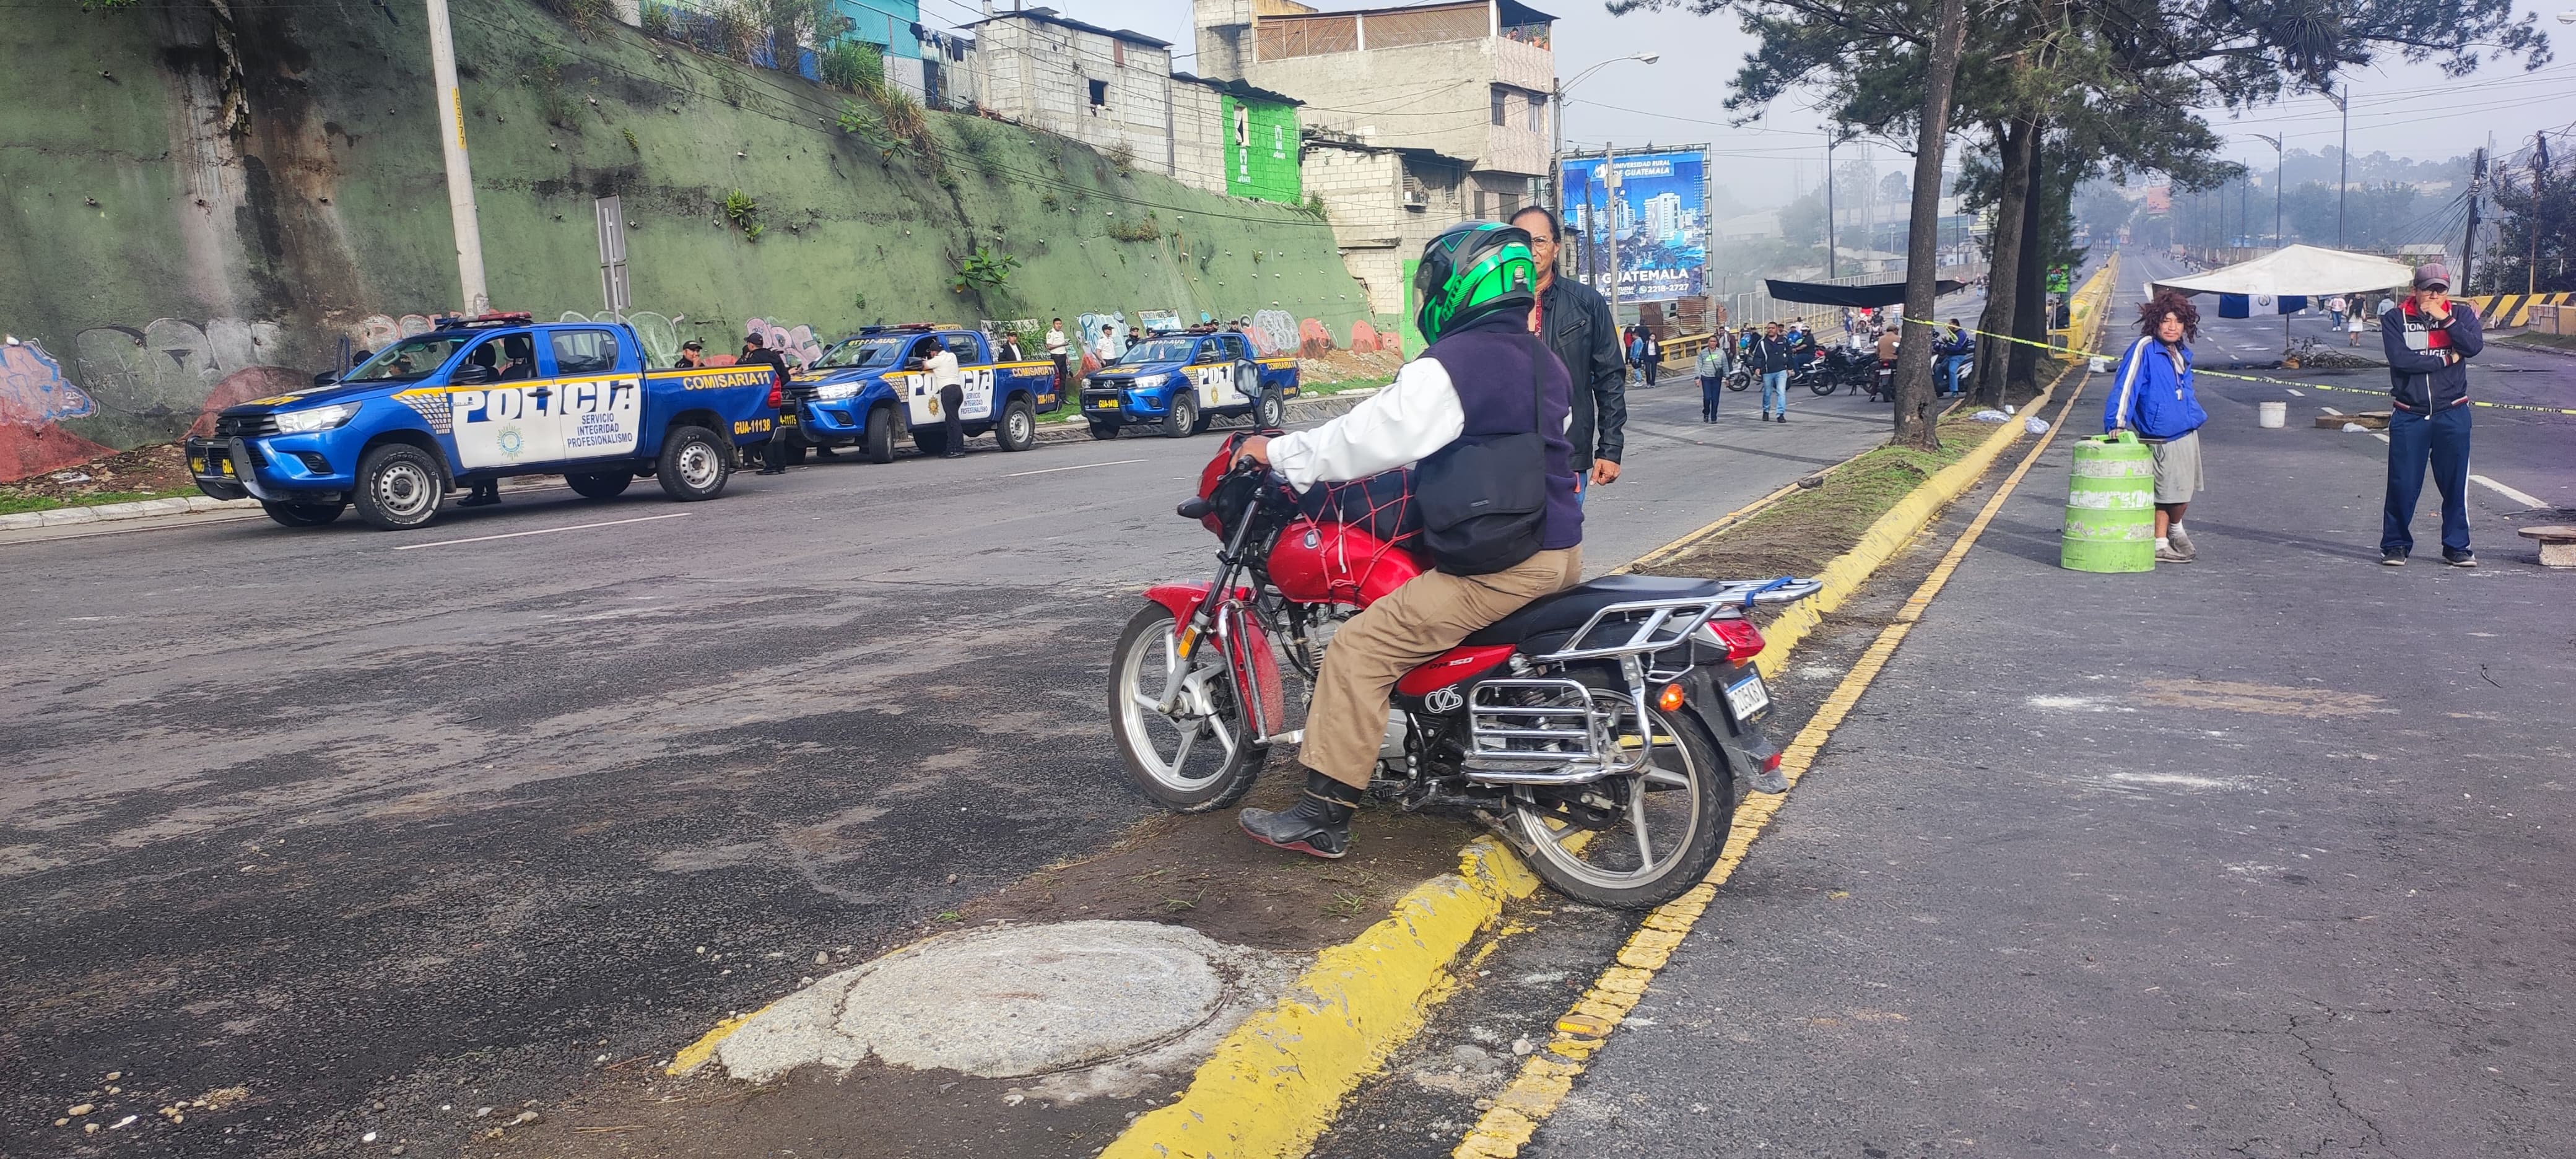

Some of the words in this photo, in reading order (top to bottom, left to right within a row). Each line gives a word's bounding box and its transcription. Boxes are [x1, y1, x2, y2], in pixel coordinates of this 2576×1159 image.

[1624, 167, 1670, 176] GUATEMALA
[1648, 284, 1689, 293] 2218-2727
[909, 371, 991, 395] POCIA
[451, 379, 640, 423] POLICIA
[2492, 403, 2562, 413] PRECAUCION
[581, 413, 614, 424] SERVICIO
[577, 423, 619, 436] INTEGRIDAD
[734, 419, 771, 435] GUA-11138
[567, 432, 632, 448] PROFESIONALISMO
